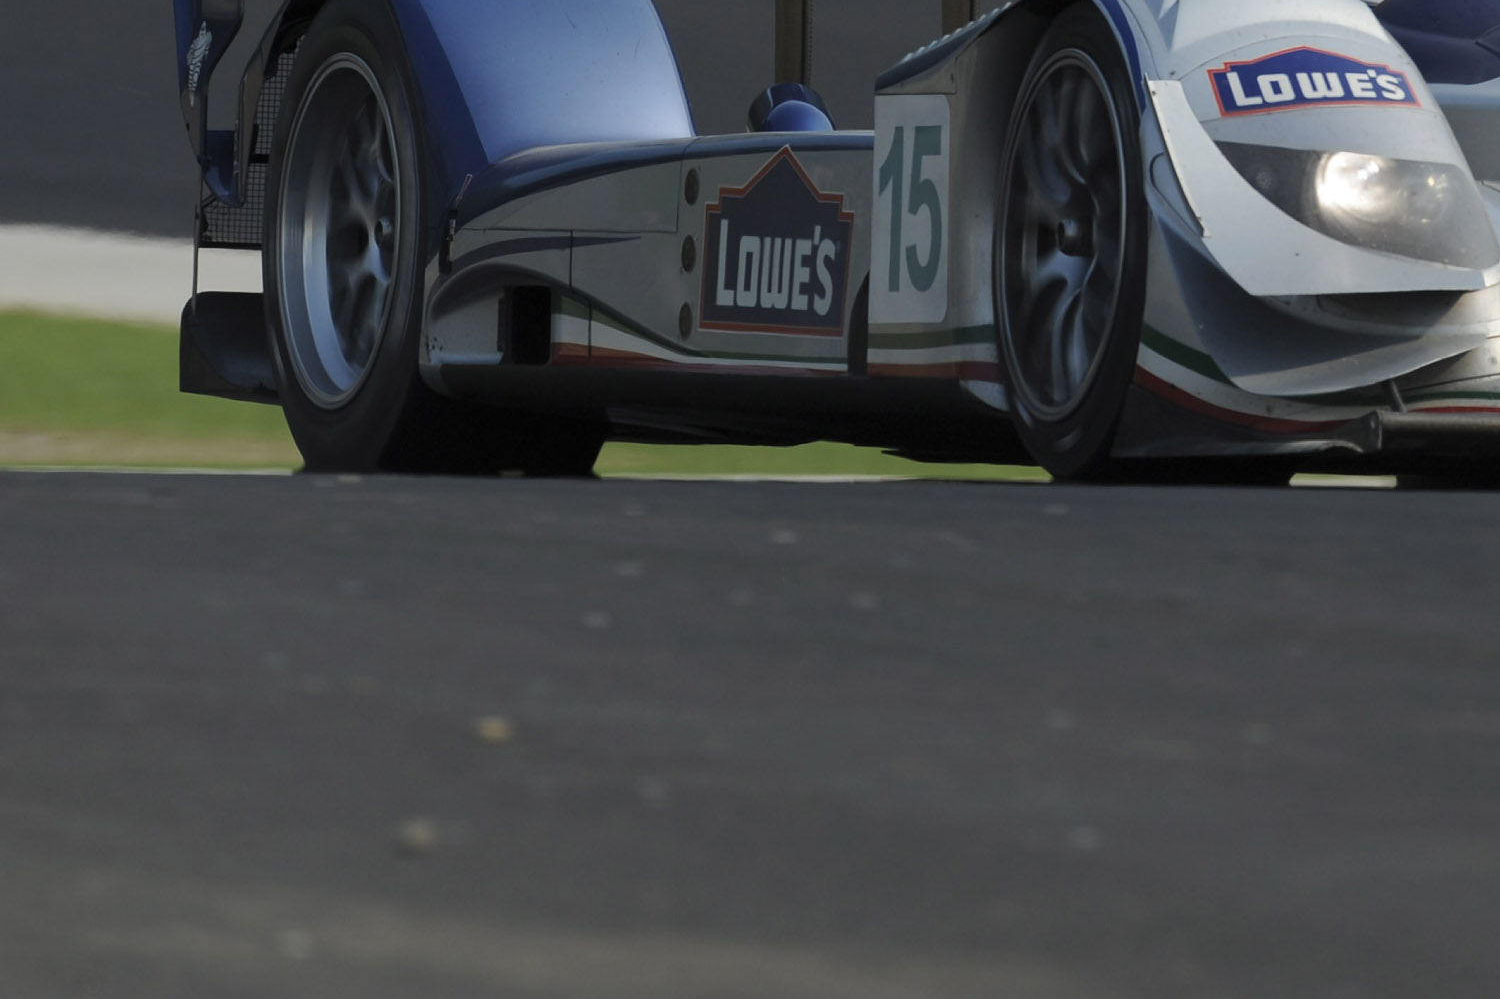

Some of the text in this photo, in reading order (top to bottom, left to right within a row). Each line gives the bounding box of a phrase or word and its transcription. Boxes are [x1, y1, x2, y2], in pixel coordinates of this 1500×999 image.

[1226, 69, 1406, 107] LOWE'S
[878, 125, 943, 292] 15
[716, 219, 837, 316] LOWE'S
